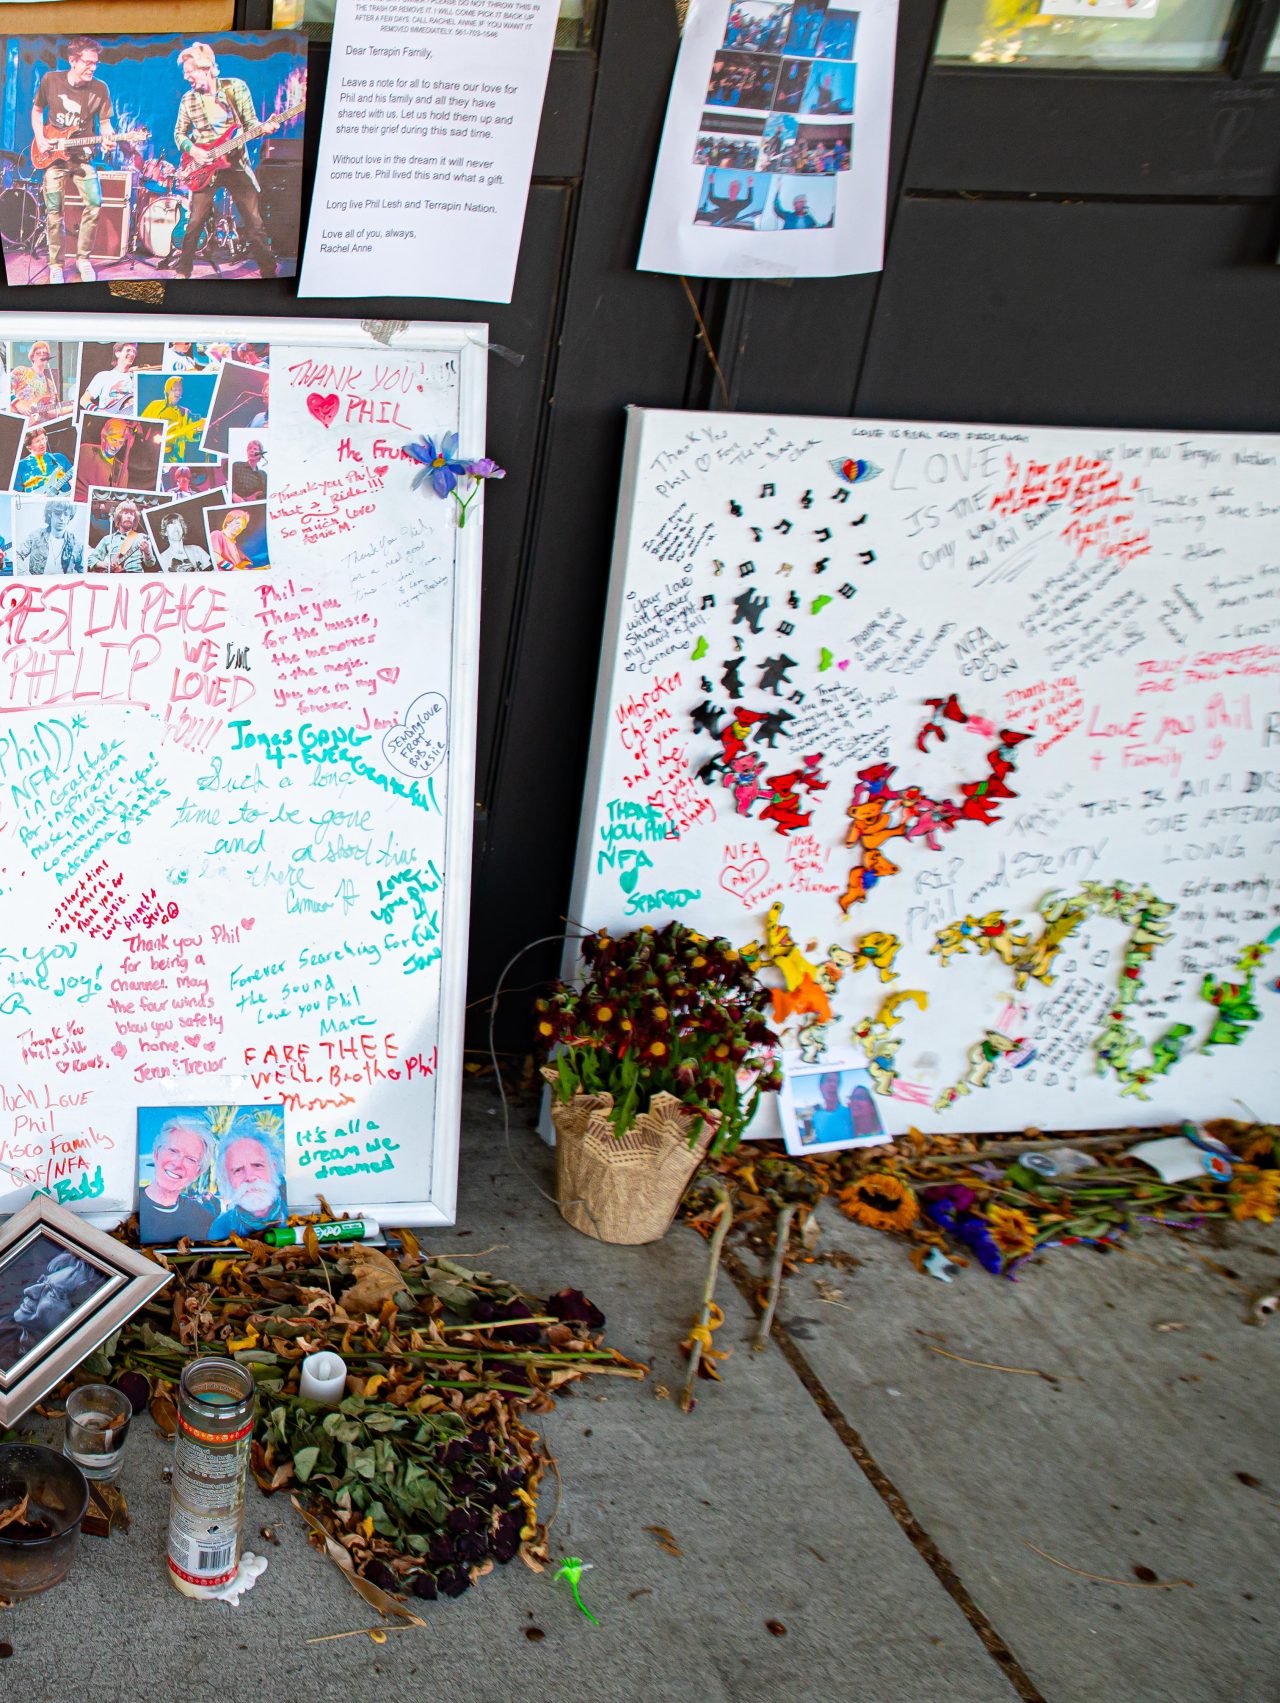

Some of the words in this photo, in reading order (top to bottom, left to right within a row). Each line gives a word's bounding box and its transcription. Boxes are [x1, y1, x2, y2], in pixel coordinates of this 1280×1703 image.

[345, 45, 367, 56] Dear
[368, 45, 401, 58] Terrapin
[402, 46, 433, 60] Family,
[339, 92, 356, 103] Phil
[357, 93, 374, 103] and
[374, 93, 387, 104] his
[388, 93, 414, 106] family
[415, 94, 433, 105] and
[434, 95, 447, 105] all
[448, 96, 470, 109] they
[471, 97, 496, 109] have
[341, 77, 368, 88] Leave
[376, 79, 394, 88] note
[396, 77, 409, 88] for
[409, 78, 420, 89] all
[421, 79, 431, 89] to
[432, 79, 461, 91] share
[462, 83, 480, 92] our
[481, 82, 502, 94] love
[503, 83, 519, 95] for
[336, 124, 360, 134] share
[361, 124, 380, 134] their
[380, 124, 400, 136] grief
[400, 124, 429, 137] during
[430, 126, 448, 136] this
[449, 127, 469, 137] sad
[470, 128, 494, 139] time.
[337, 108, 367, 119] shared
[368, 109, 385, 119] with
[386, 110, 398, 119] us.
[400, 109, 415, 119] Let
[416, 111, 428, 120] us
[429, 110, 451, 121] hold
[452, 111, 478, 123] them
[479, 115, 493, 125] up
[493, 115, 514, 126] and
[326, 199, 348, 212] Long
[349, 199, 364, 209] live
[364, 199, 381, 208] Phil
[382, 199, 403, 209] Lesh
[404, 199, 422, 209] and
[424, 199, 462, 212] Terrapin
[463, 202, 498, 214] Nation.
[319, 243, 350, 253] Rachel
[350, 243, 373, 253] Anne
[322, 229, 343, 239] Love
[344, 229, 355, 239] all
[356, 228, 366, 238] of
[365, 230, 383, 240] you,
[384, 228, 417, 240] always,
[288, 358, 363, 392] THANK
[370, 362, 425, 394] YOU!
[345, 393, 412, 431] PHIL
[891, 443, 1004, 491] LOVE
[947, 484, 991, 522] THE
[84, 582, 129, 637] IN
[139, 580, 229, 634] PEACE
[1, 633, 162, 706] PHILIP
[182, 638, 219, 672] WE
[169, 666, 257, 713] LOVED
[615, 671, 683, 726] Unbroken
[618, 707, 672, 750] Chain
[606, 798, 663, 823] THANK
[643, 821, 680, 841] PHIL
[597, 849, 654, 874] NFA
[723, 844, 763, 861] NFA
[243, 1042, 309, 1066] FARE
[318, 1033, 401, 1061] THEE
[405, 1044, 439, 1082] Phil
